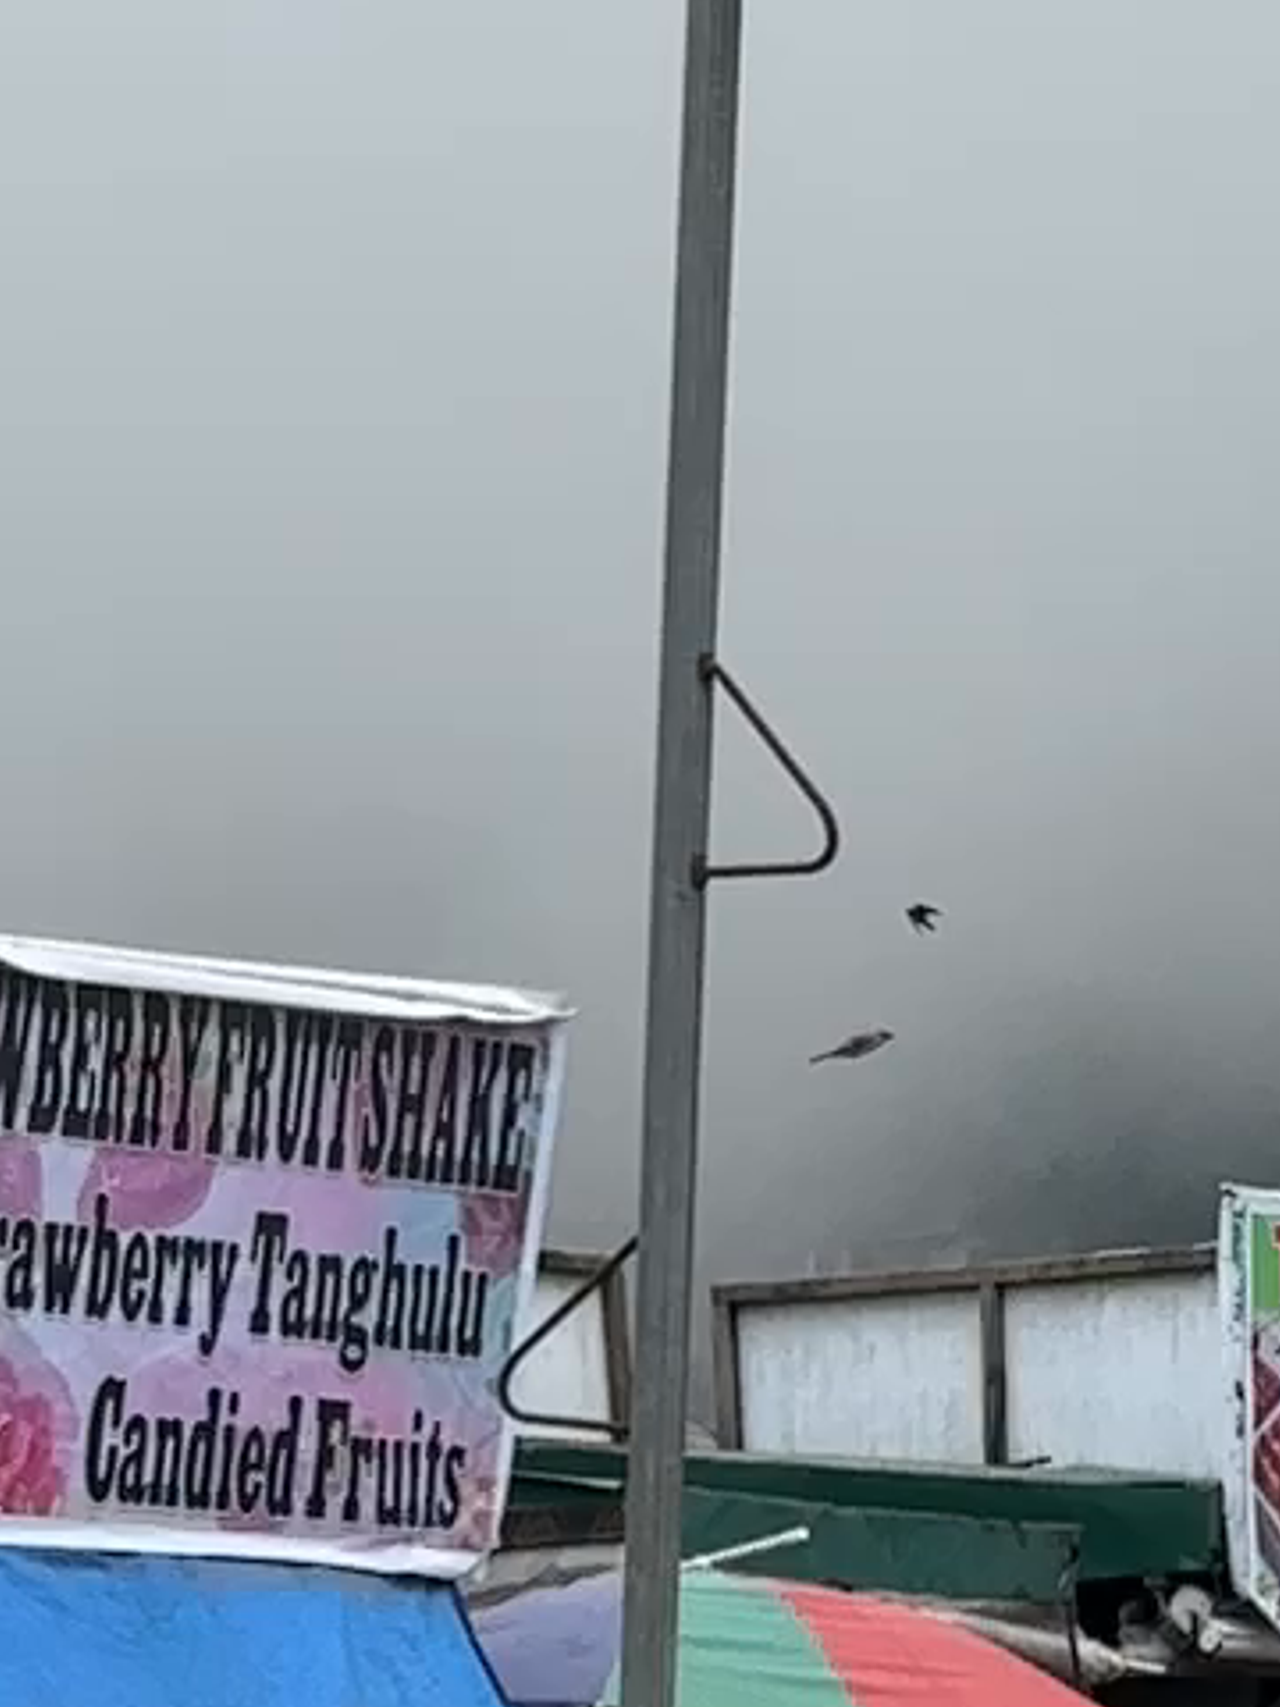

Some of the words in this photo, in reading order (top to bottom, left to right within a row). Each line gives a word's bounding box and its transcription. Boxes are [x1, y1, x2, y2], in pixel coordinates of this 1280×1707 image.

[206, 997, 363, 1169] FRUIT
[358, 1025, 538, 1191] SHAKE
[248, 1210, 489, 1371] Tanghulu
[85, 1376, 302, 1519] Candied
[304, 1397, 466, 1529] Fruits
